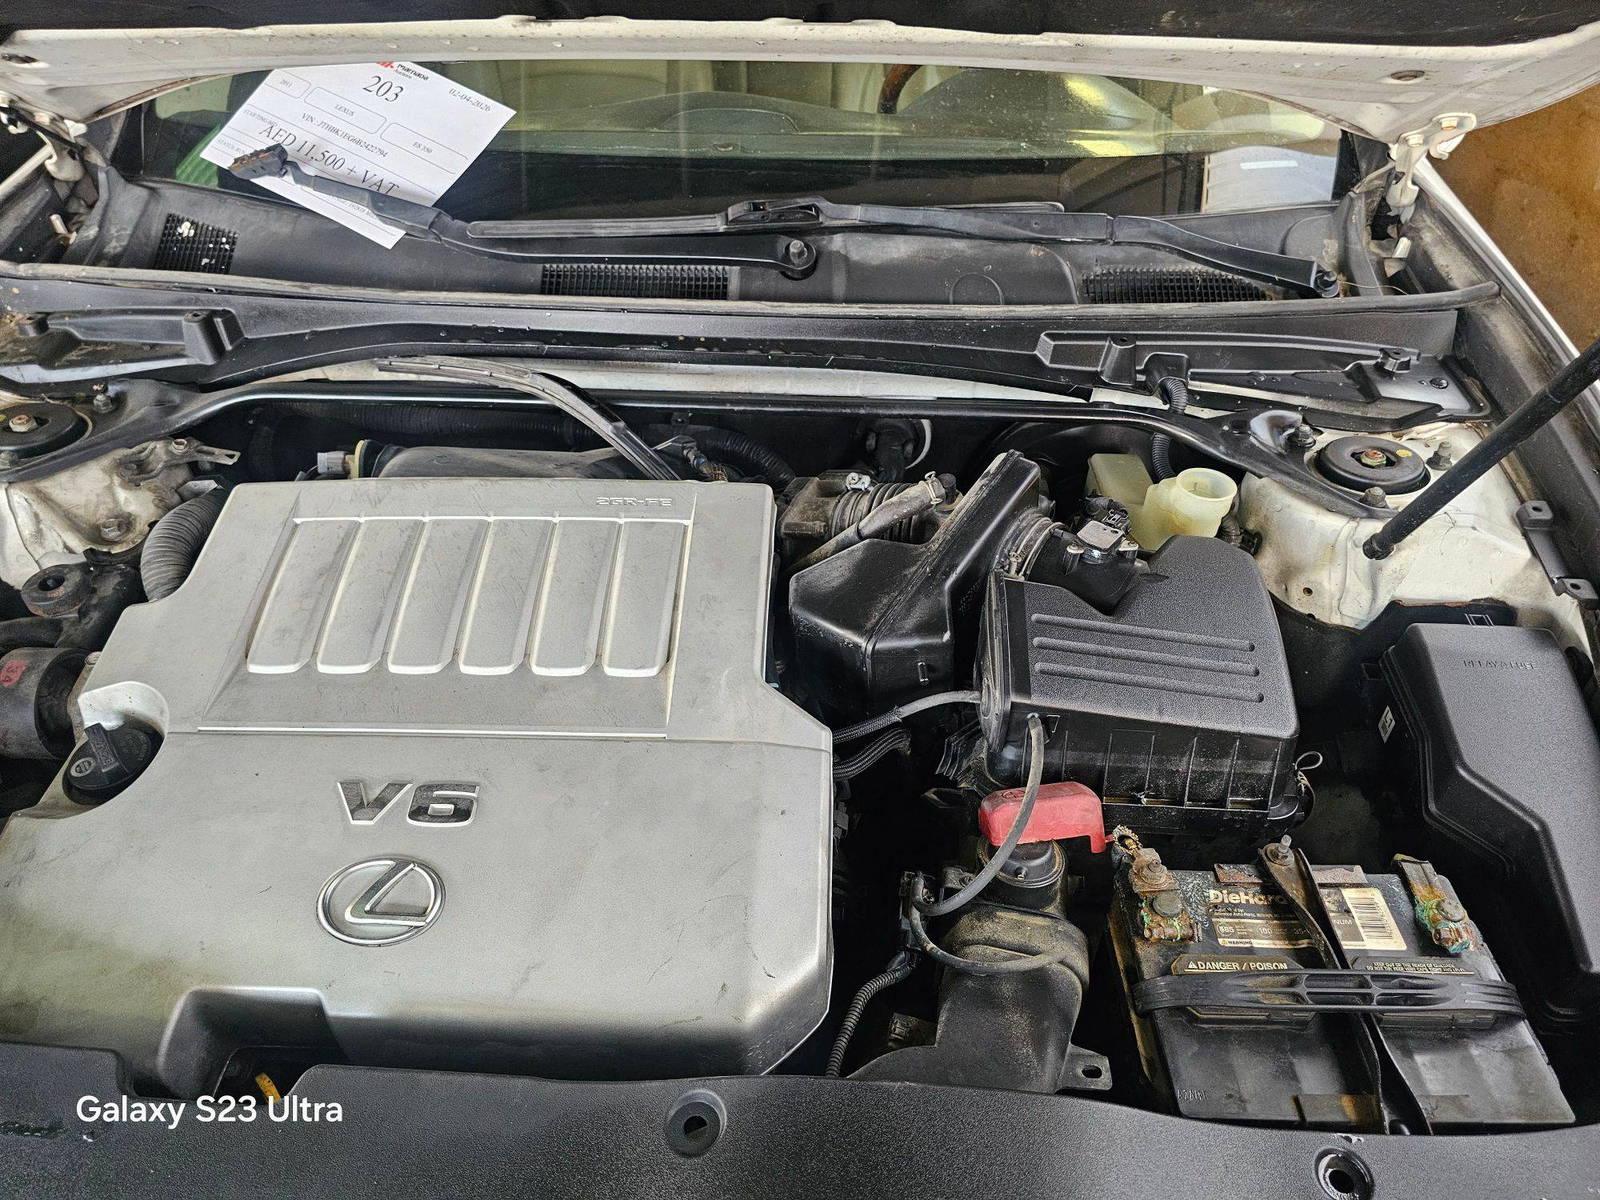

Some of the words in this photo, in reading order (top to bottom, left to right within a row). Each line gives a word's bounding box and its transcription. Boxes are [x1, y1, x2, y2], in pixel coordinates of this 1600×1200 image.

[363, 75, 404, 102] 203
[334, 103, 355, 117] LEXUS
[259, 125, 297, 147] AED
[298, 140, 346, 171] 11,500
[361, 170, 400, 194] VAT
[337, 782, 480, 828] V6
[1198, 961, 1240, 970] DANGER
[1250, 962, 1288, 970] POISON
